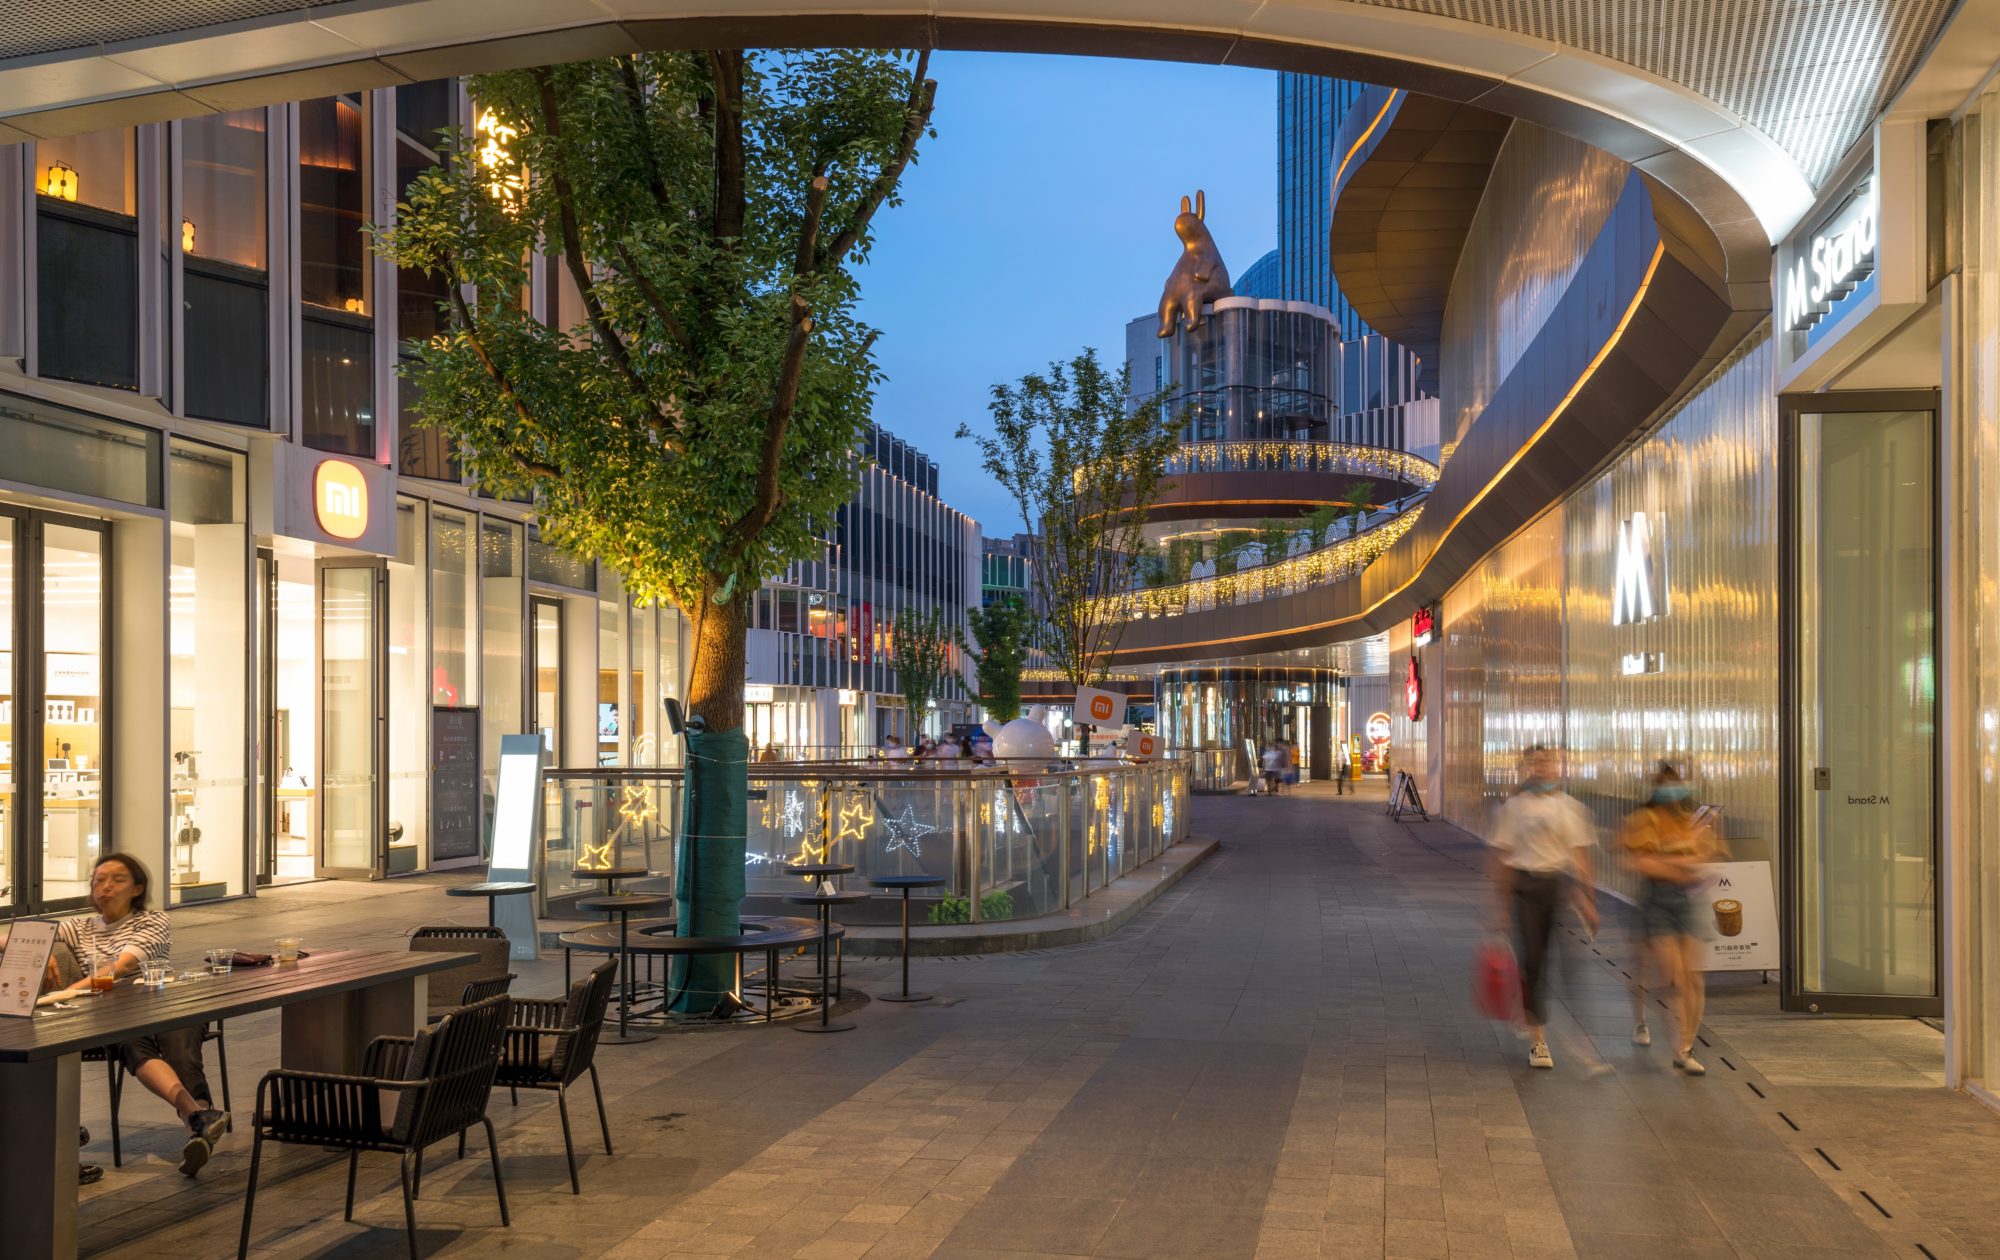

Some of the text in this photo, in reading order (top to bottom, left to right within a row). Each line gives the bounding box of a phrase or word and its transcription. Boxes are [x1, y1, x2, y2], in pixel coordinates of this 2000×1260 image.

[1785, 176, 1876, 332] M Stand
[1613, 511, 1653, 626] M
[1718, 878, 1732, 887] M
